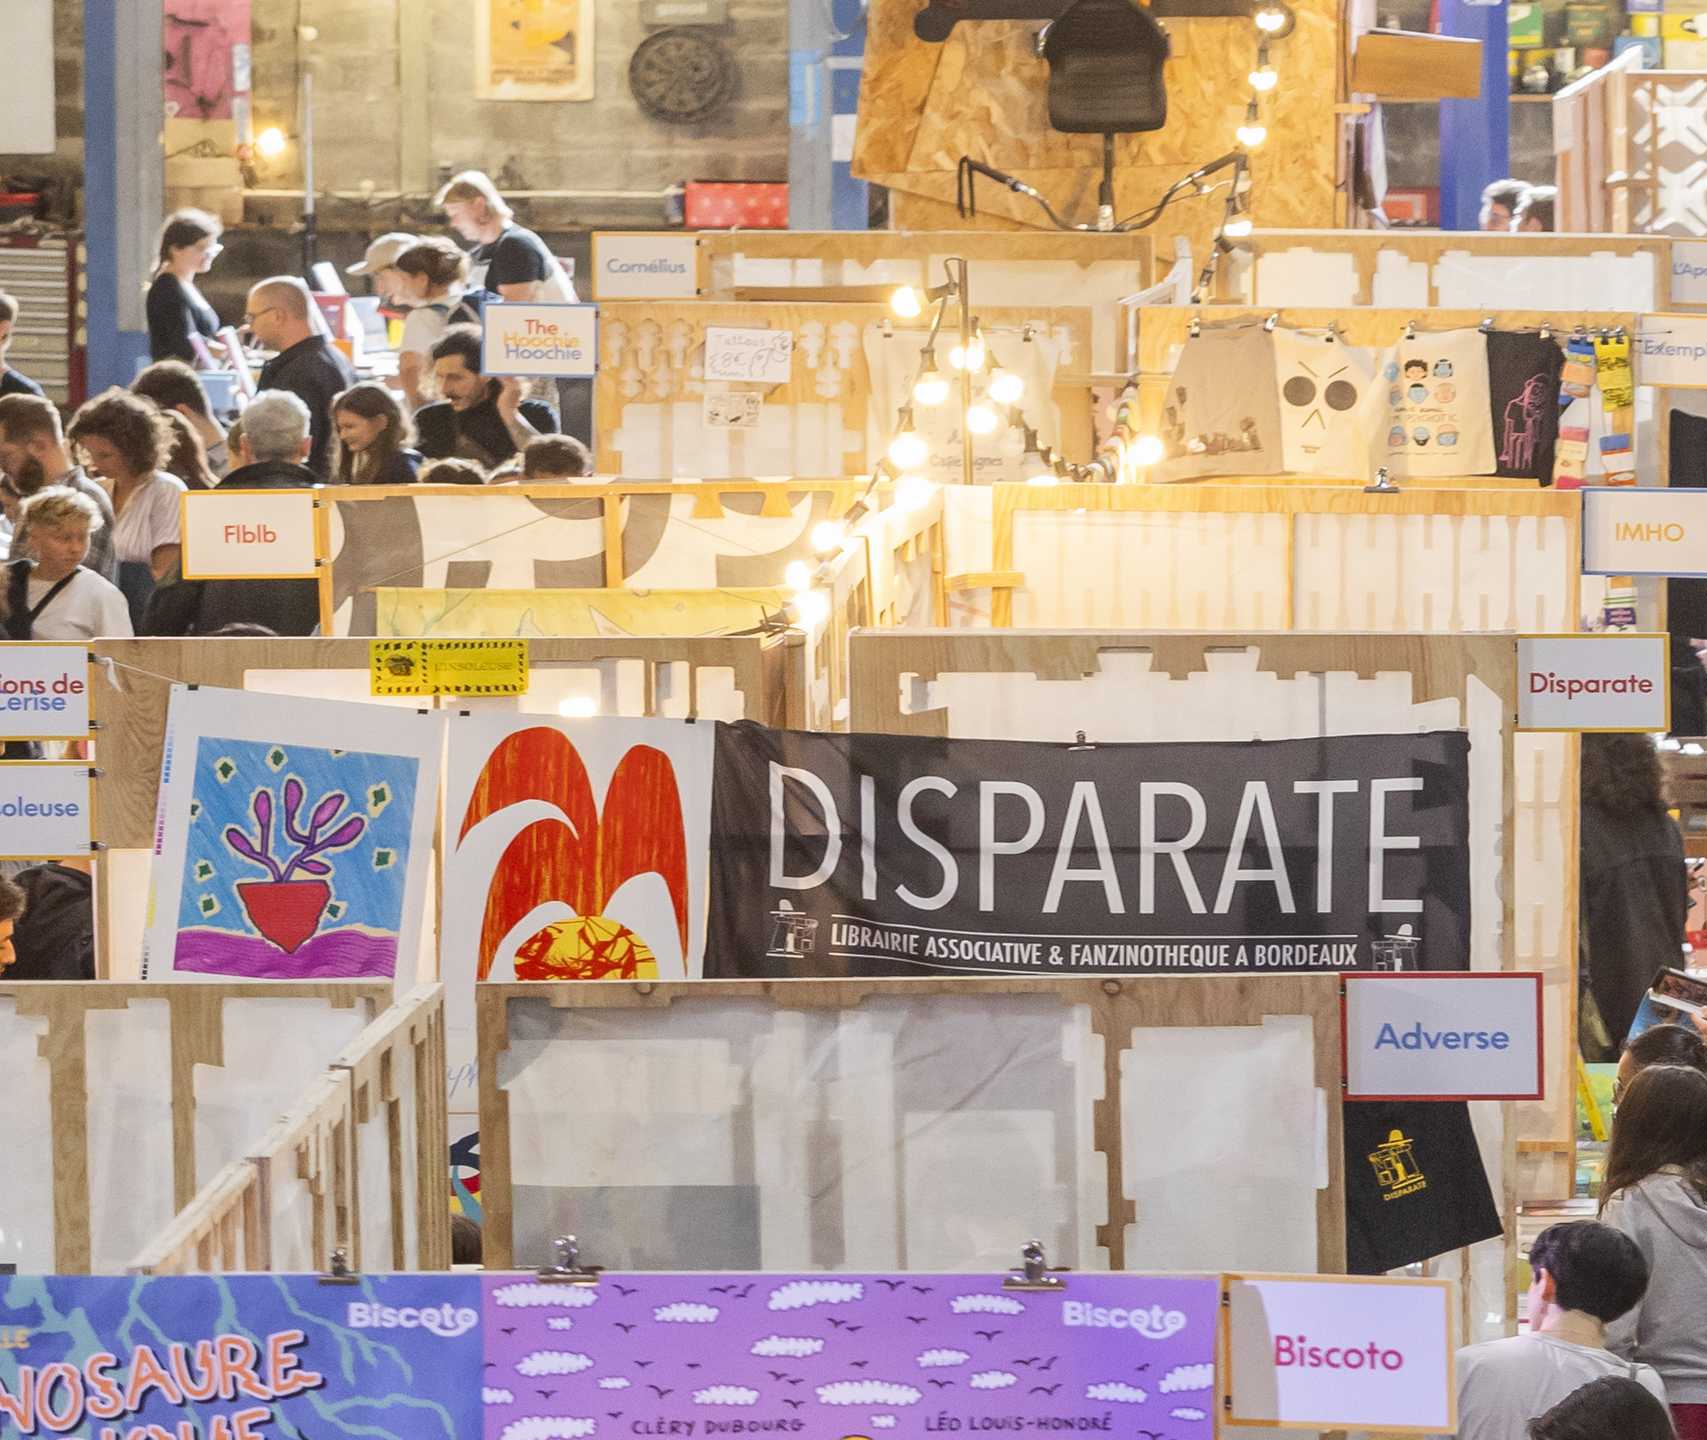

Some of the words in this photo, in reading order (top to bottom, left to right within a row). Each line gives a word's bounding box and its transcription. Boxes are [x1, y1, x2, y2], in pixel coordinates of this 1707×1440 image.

[607, 257, 686, 274] Cornélius
[525, 319, 559, 336] The
[503, 333, 581, 352] Hoochie
[504, 344, 583, 361] Hoochie
[224, 524, 277, 545] Flblb
[1615, 522, 1685, 543] IMHO
[52, 672, 85, 694] de
[1527, 671, 1654, 701] Disparate
[0, 796, 79, 818] oleuse
[768, 760, 1424, 916] DISPARATE
[830, 922, 920, 957] LIBRAIRIE
[925, 929, 1042, 967] ASSOCIATIVE
[1048, 941, 1063, 967] &
[1069, 941, 1229, 969] FANZINOTHEQUE
[1235, 943, 1250, 967] A
[1254, 942, 1358, 967] BORDEAUX
[1374, 1021, 1510, 1051] Adverse
[348, 1301, 480, 1338] Biscoto
[1063, 1300, 1187, 1341] Biscoto
[1273, 1334, 1405, 1373] Biscoto
[704, 1416, 806, 1435] DUBOURG
[924, 1411, 964, 1434] LÉO
